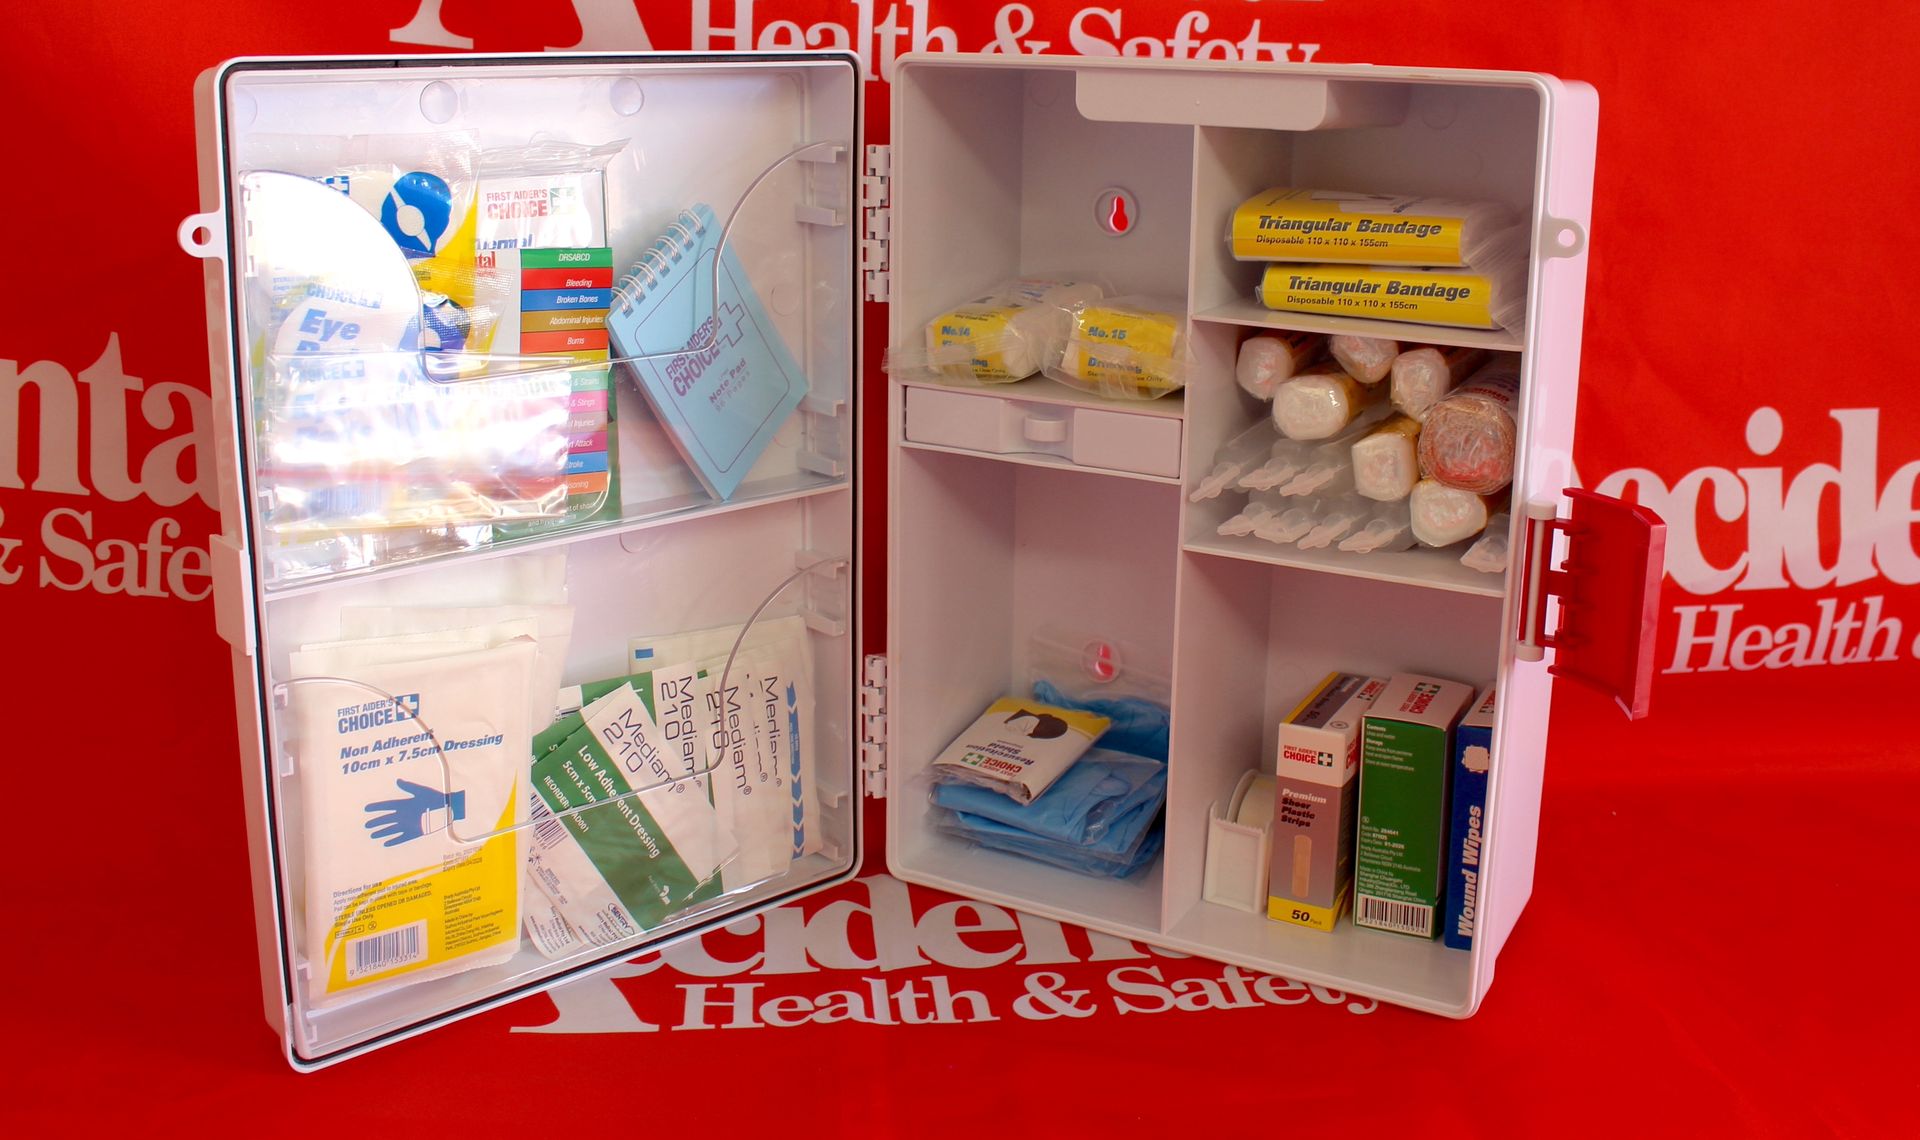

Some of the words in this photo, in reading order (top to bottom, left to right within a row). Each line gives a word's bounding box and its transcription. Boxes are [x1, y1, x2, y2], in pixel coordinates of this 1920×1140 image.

[487, 191, 511, 202] FIRST
[513, 189, 548, 200] AIDER'S
[488, 200, 547, 219] CHOICE
[1259, 216, 1352, 234] Triangular
[1356, 219, 1442, 238] Bandage
[1256, 235, 1304, 247] Disposable
[1307, 237, 1323, 246] 110
[1333, 237, 1349, 246] 110
[1359, 238, 1389, 248] 155cm
[558, 253, 590, 262] DRSABCD
[565, 279, 593, 288] Bleeding
[1288, 275, 1381, 295] Triangular
[1385, 280, 1470, 301] Bandage
[556, 296, 578, 304] Broken
[579, 295, 598, 303] Bones
[1287, 295, 1335, 307] Disposable
[1337, 298, 1352, 307] 110
[1362, 299, 1379, 308] 110
[1389, 300, 1418, 310] 155cm
[299, 308, 360, 342] Eye
[550, 316, 581, 325] Abdominal
[567, 337, 585, 345] Burns
[1088, 326, 1108, 338] No.
[1111, 328, 1127, 340] 15
[672, 343, 720, 397] CHOICE
[709, 380, 730, 403] Note
[729, 358, 748, 379] Pad
[577, 398, 596, 408] Stings
[575, 439, 593, 448] Attack
[1662, 595, 1902, 674] Health
[338, 705, 361, 717] FIRST
[362, 699, 393, 714] AIDER'S
[661, 680, 680, 740] 210
[338, 708, 393, 734] CHOICE
[340, 746, 368, 760] Non
[372, 729, 434, 752] Adherent
[342, 760, 380, 774] 10cm
[385, 756, 393, 765] x
[399, 745, 440, 762] 7.5cm
[444, 733, 504, 752] Dressing
[603, 722, 643, 773] 210
[988, 742, 1021, 755] Shield
[966, 744, 1034, 766] Resuscitation
[1283, 750, 1316, 764] CHOICE
[984, 757, 1023, 773] CHOICE
[563, 760, 580, 781] 5cm
[576, 780, 584, 788] x
[581, 785, 597, 804] 5cm
[543, 775, 570, 809] REORDER:
[570, 807, 589, 833] AD001
[578, 745, 599, 771] Low
[629, 814, 660, 859] Dressing
[1281, 797, 1311, 809] Sheer
[1282, 788, 1327, 804] Premium
[1281, 806, 1316, 819] Plastic
[1281, 815, 1311, 827] Strips
[1462, 805, 1482, 866] Wipes
[333, 886, 362, 898] Directions
[1458, 869, 1477, 936] Wound
[611, 906, 628, 928] SENTRY
[1291, 909, 1310, 922] 50
[671, 975, 1000, 1031] Health
[1012, 971, 1097, 1020] &
